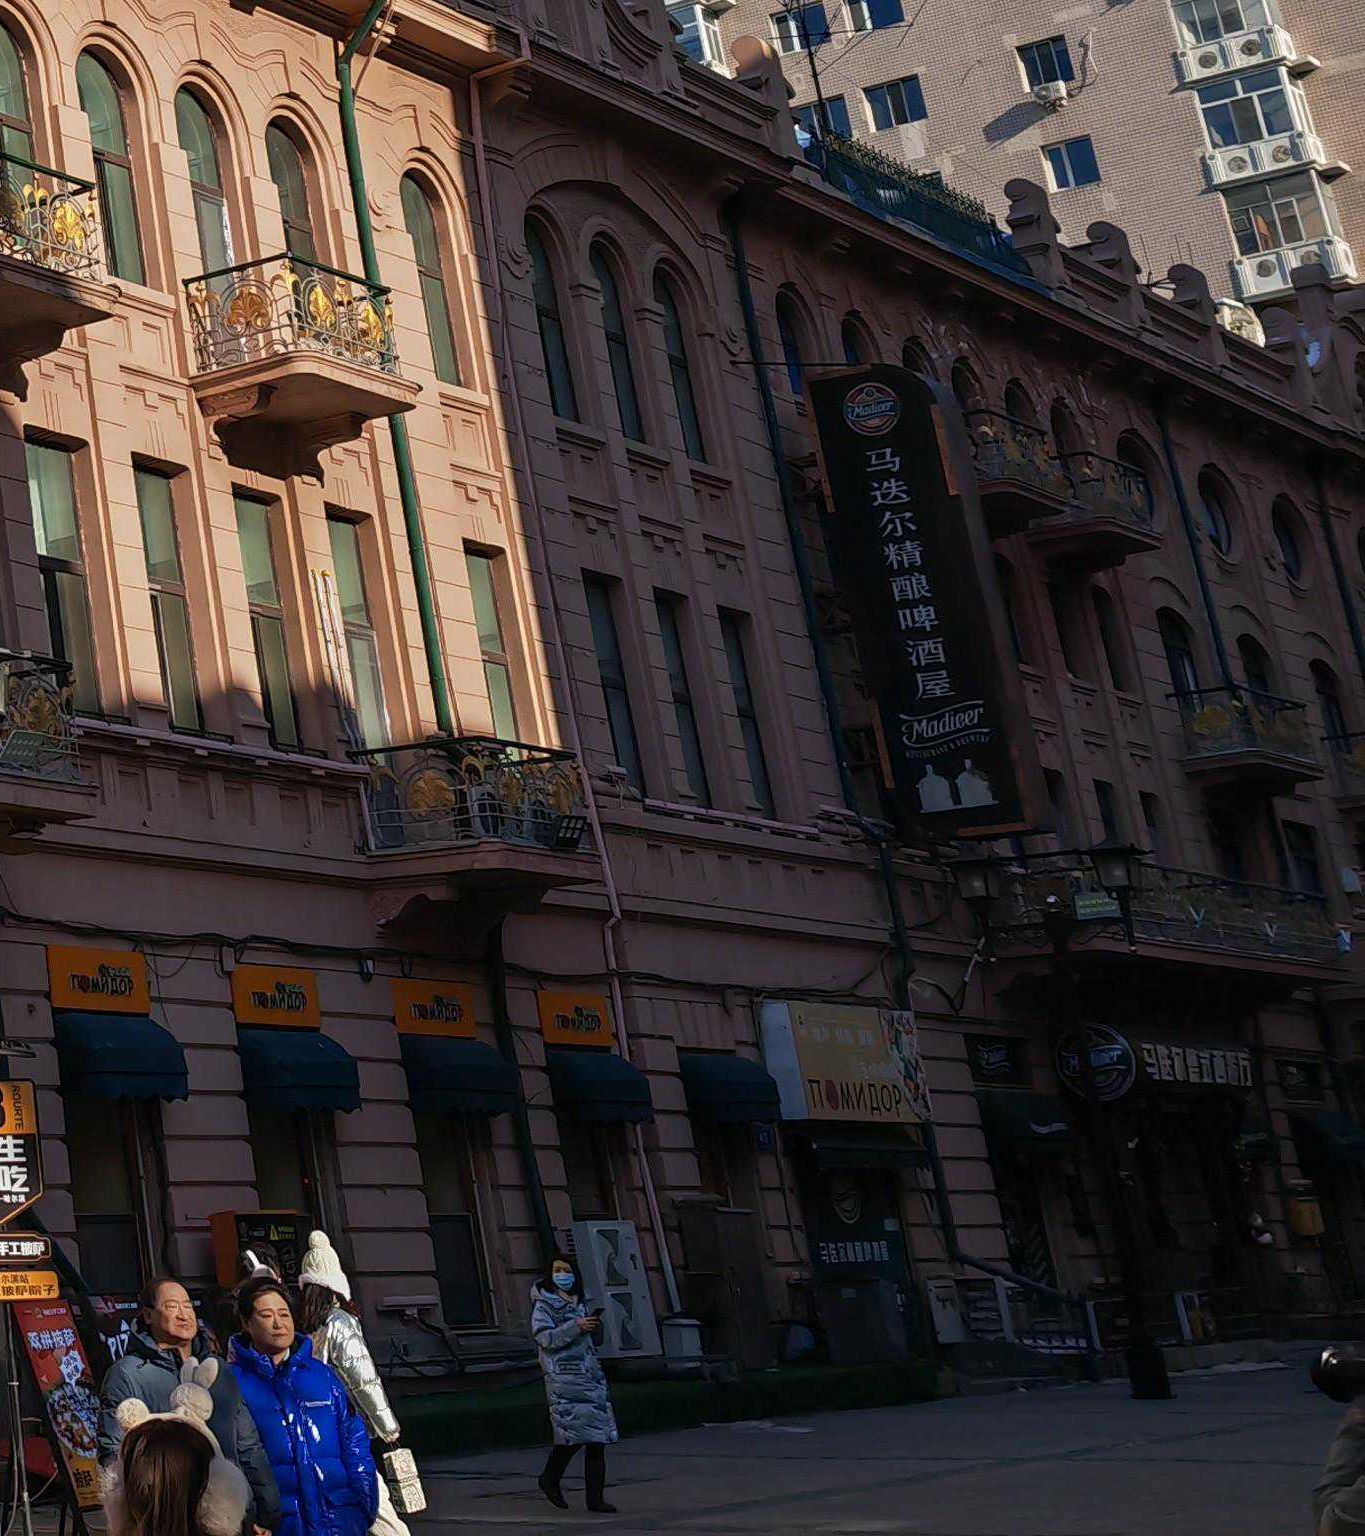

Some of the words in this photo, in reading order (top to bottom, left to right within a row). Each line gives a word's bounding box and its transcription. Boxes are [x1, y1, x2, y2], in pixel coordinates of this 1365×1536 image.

[863, 447, 957, 701] 马迭尔精酿啤酒屋
